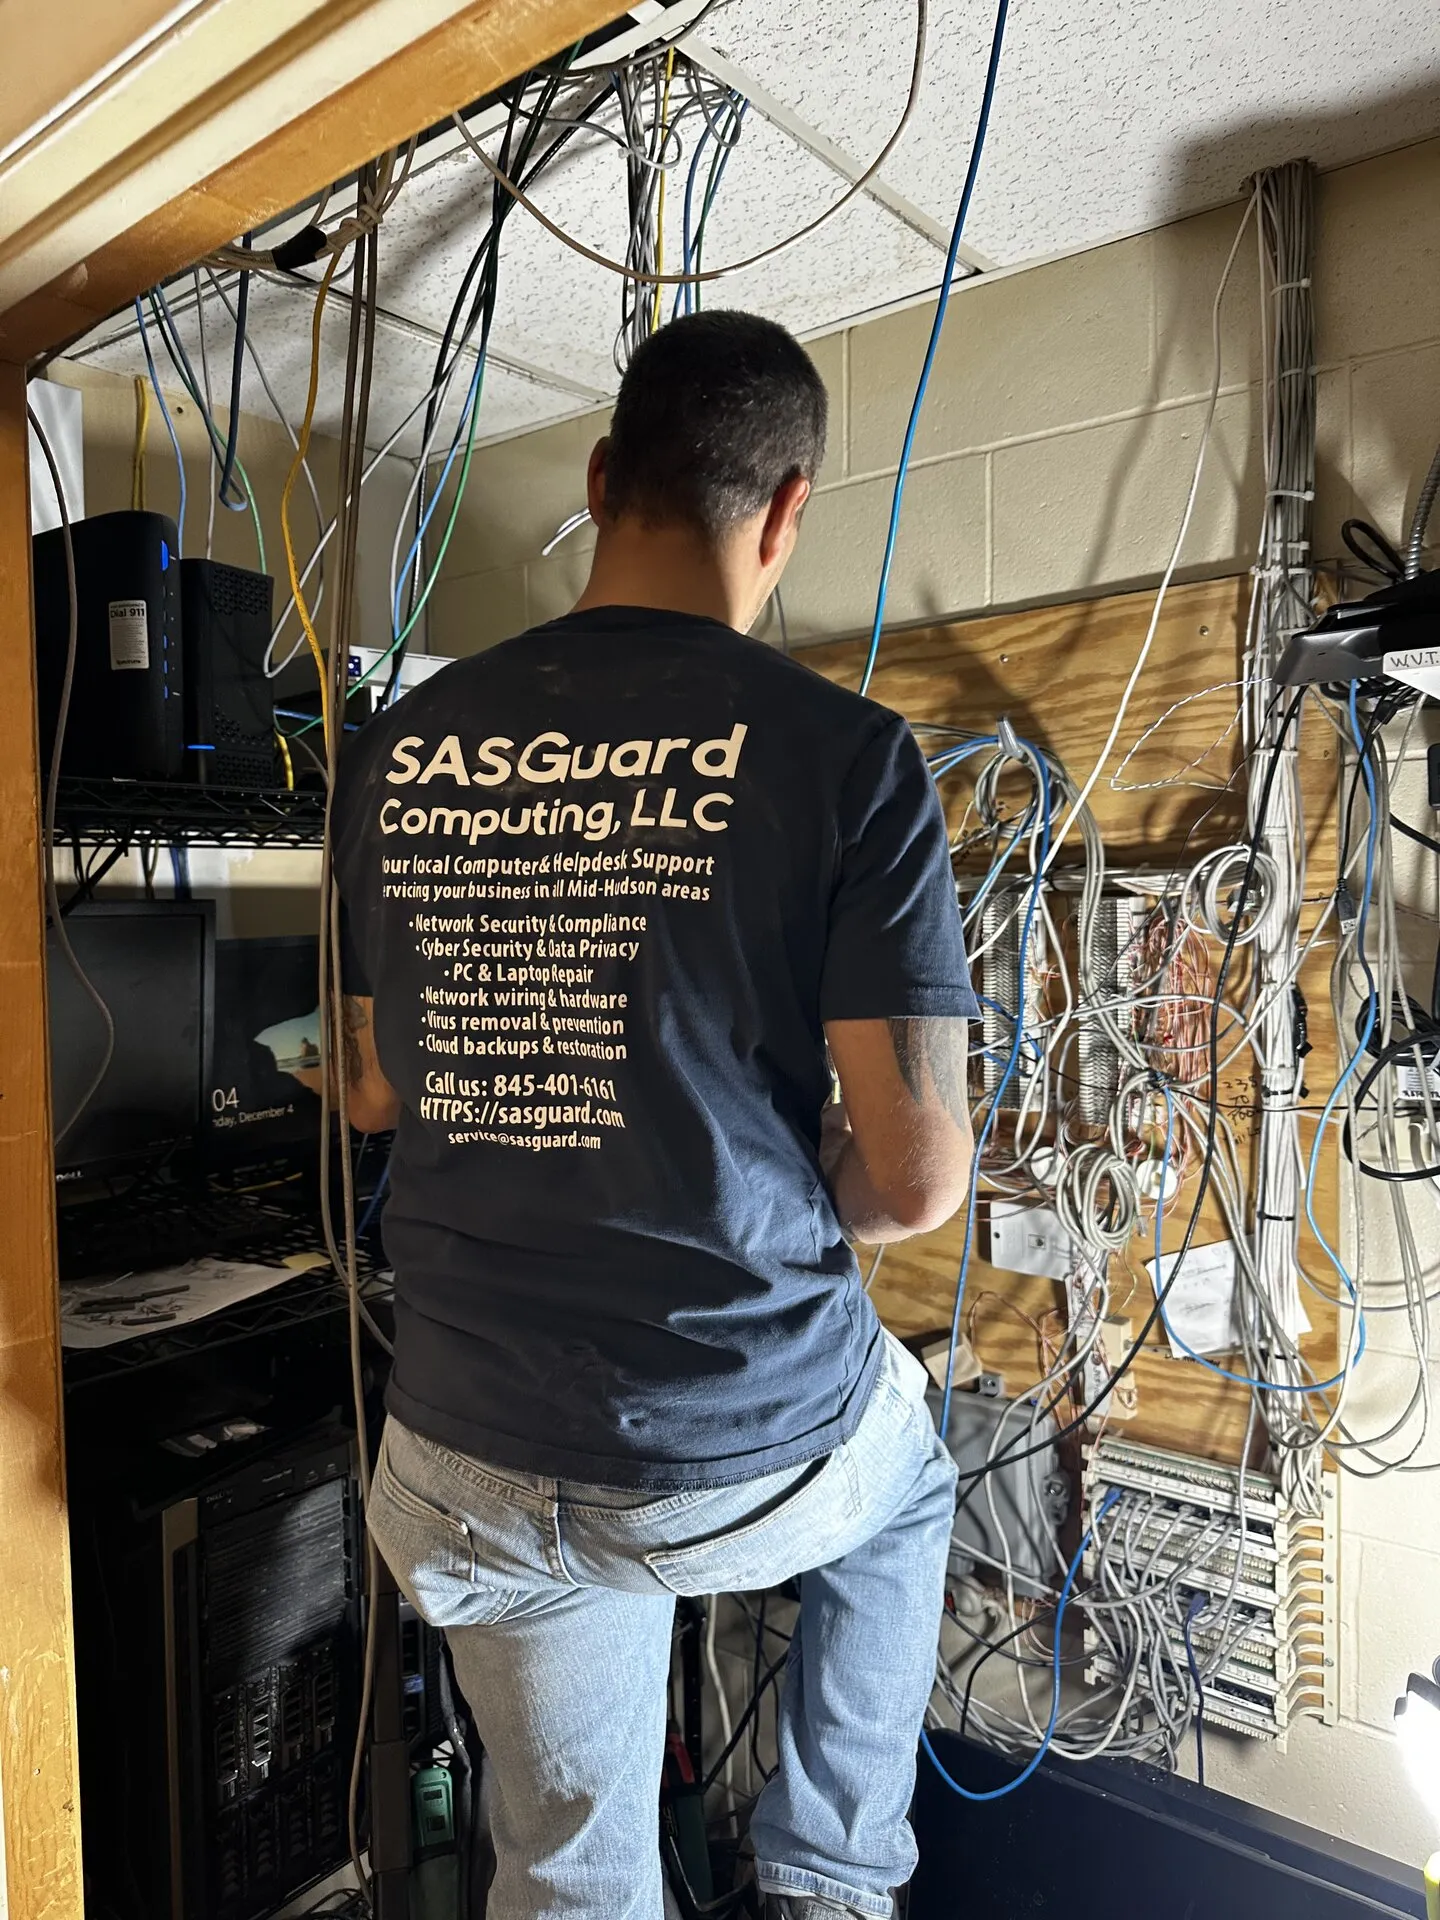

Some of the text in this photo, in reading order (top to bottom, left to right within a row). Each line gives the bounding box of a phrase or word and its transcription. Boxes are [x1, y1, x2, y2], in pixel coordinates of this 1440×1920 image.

[111, 608, 145, 618] Dial 911
[386, 723, 747, 786] SASGuard
[380, 788, 734, 845] Computing, LLC
[413, 855, 450, 874] local
[554, 849, 629, 877] Helpdesk
[632, 848, 714, 876] Support
[433, 885, 466, 902] your
[468, 881, 531, 899] business
[535, 881, 549, 898] in
[567, 875, 656, 897] Mid-Hudson
[662, 883, 709, 901] areas
[416, 914, 474, 932] Network
[480, 915, 547, 937] Security
[558, 914, 646, 936] Compliance
[422, 939, 459, 960] Cyber
[463, 939, 532, 961] Security
[536, 939, 546, 957] &
[580, 939, 639, 961] Privacy
[454, 963, 593, 987] PC & Laptop Repair
[426, 986, 627, 1010] Network wiring & hardware
[427, 1010, 623, 1035] Virus removal & prevention
[426, 1034, 626, 1060] Cloud backups & restoration
[426, 1071, 616, 1101] Call us: 845-401-6161
[212, 1087, 240, 1112] 04
[238, 1107, 286, 1124] December
[287, 1104, 295, 1113] 4
[421, 1097, 625, 1129] HTTPS://sasguard.com
[448, 1130, 600, 1151] service@sasguard.com
